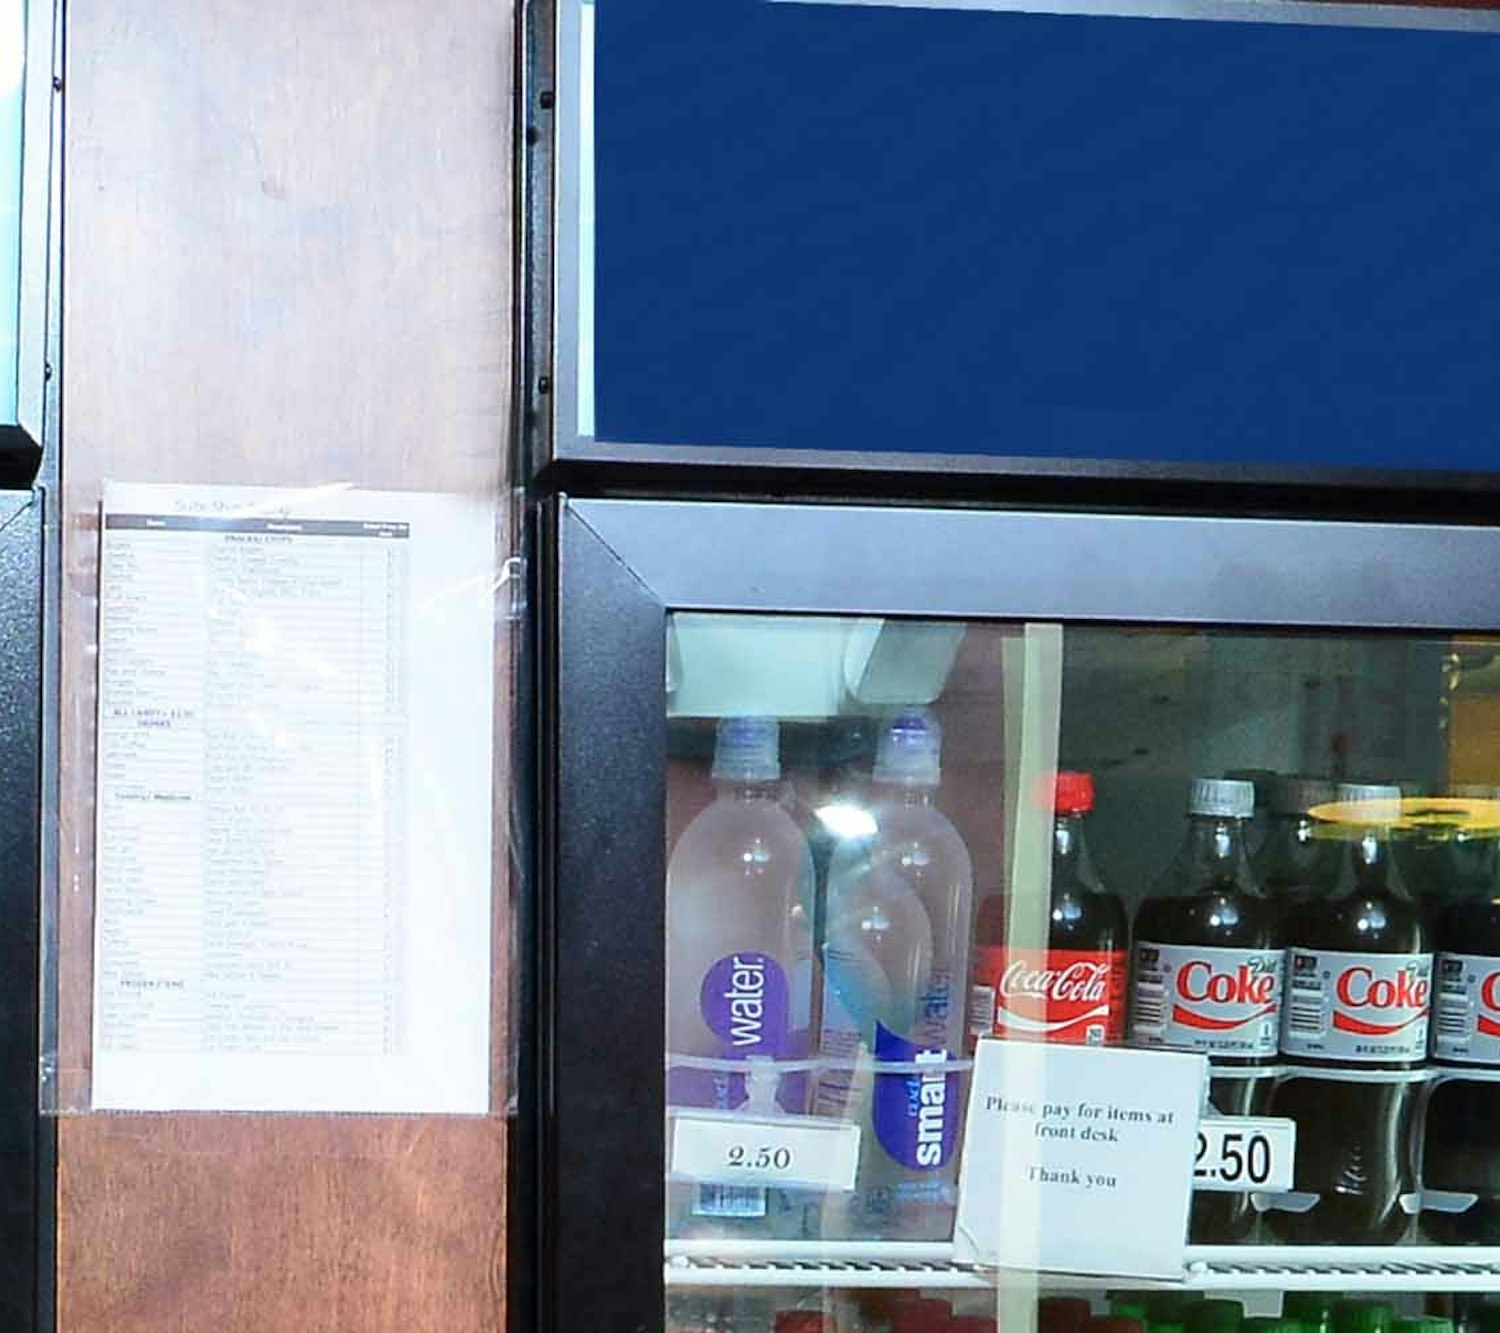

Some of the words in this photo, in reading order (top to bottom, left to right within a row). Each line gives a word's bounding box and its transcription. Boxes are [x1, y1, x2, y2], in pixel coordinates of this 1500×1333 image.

[1176, 960, 1275, 1005] Coke
[1335, 965, 1429, 1009] Coke
[722, 955, 767, 1048] water.
[915, 1048, 949, 1167] smart
[985, 1096, 1035, 1115] Please
[1042, 1104, 1070, 1120] pay
[1077, 1102, 1101, 1119] for
[1106, 1106, 1152, 1123] items
[1157, 1111, 1174, 1125] at
[1034, 1122, 1076, 1140] front
[1079, 1125, 1119, 1143] desk
[727, 1145, 791, 1170] 2.50
[1029, 1164, 1081, 1186] Thank
[1086, 1173, 1118, 1189] you
